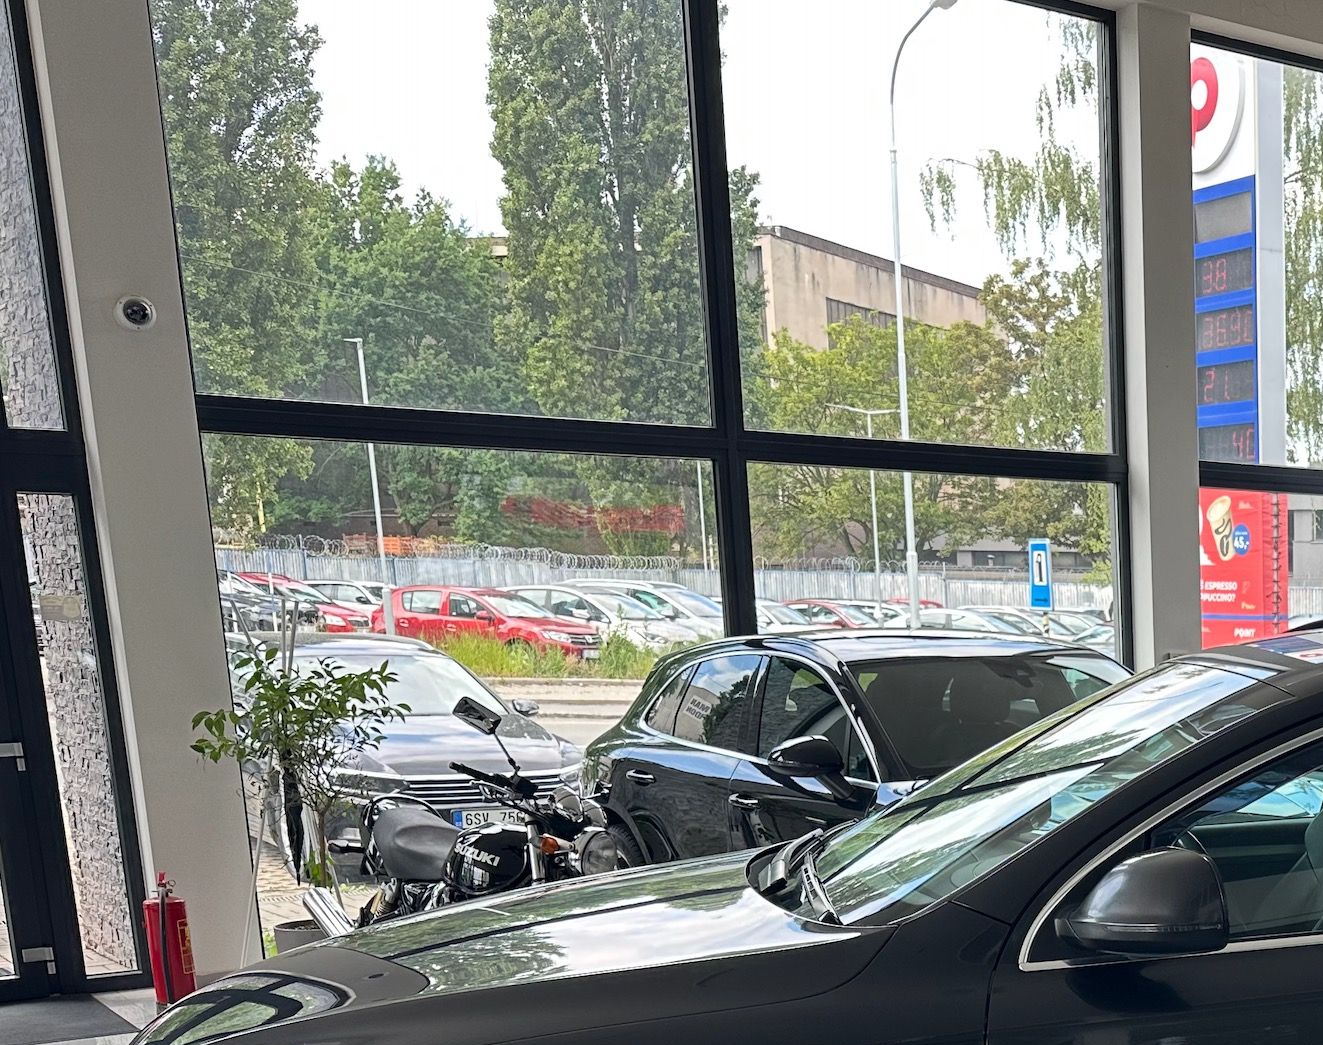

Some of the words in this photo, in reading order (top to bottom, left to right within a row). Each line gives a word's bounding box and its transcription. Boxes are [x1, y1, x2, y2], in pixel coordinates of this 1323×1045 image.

[1205, 581, 1238, 591] ESPRESSO
[465, 812, 489, 826] 6SV
[454, 842, 501, 867] SUZUKI
